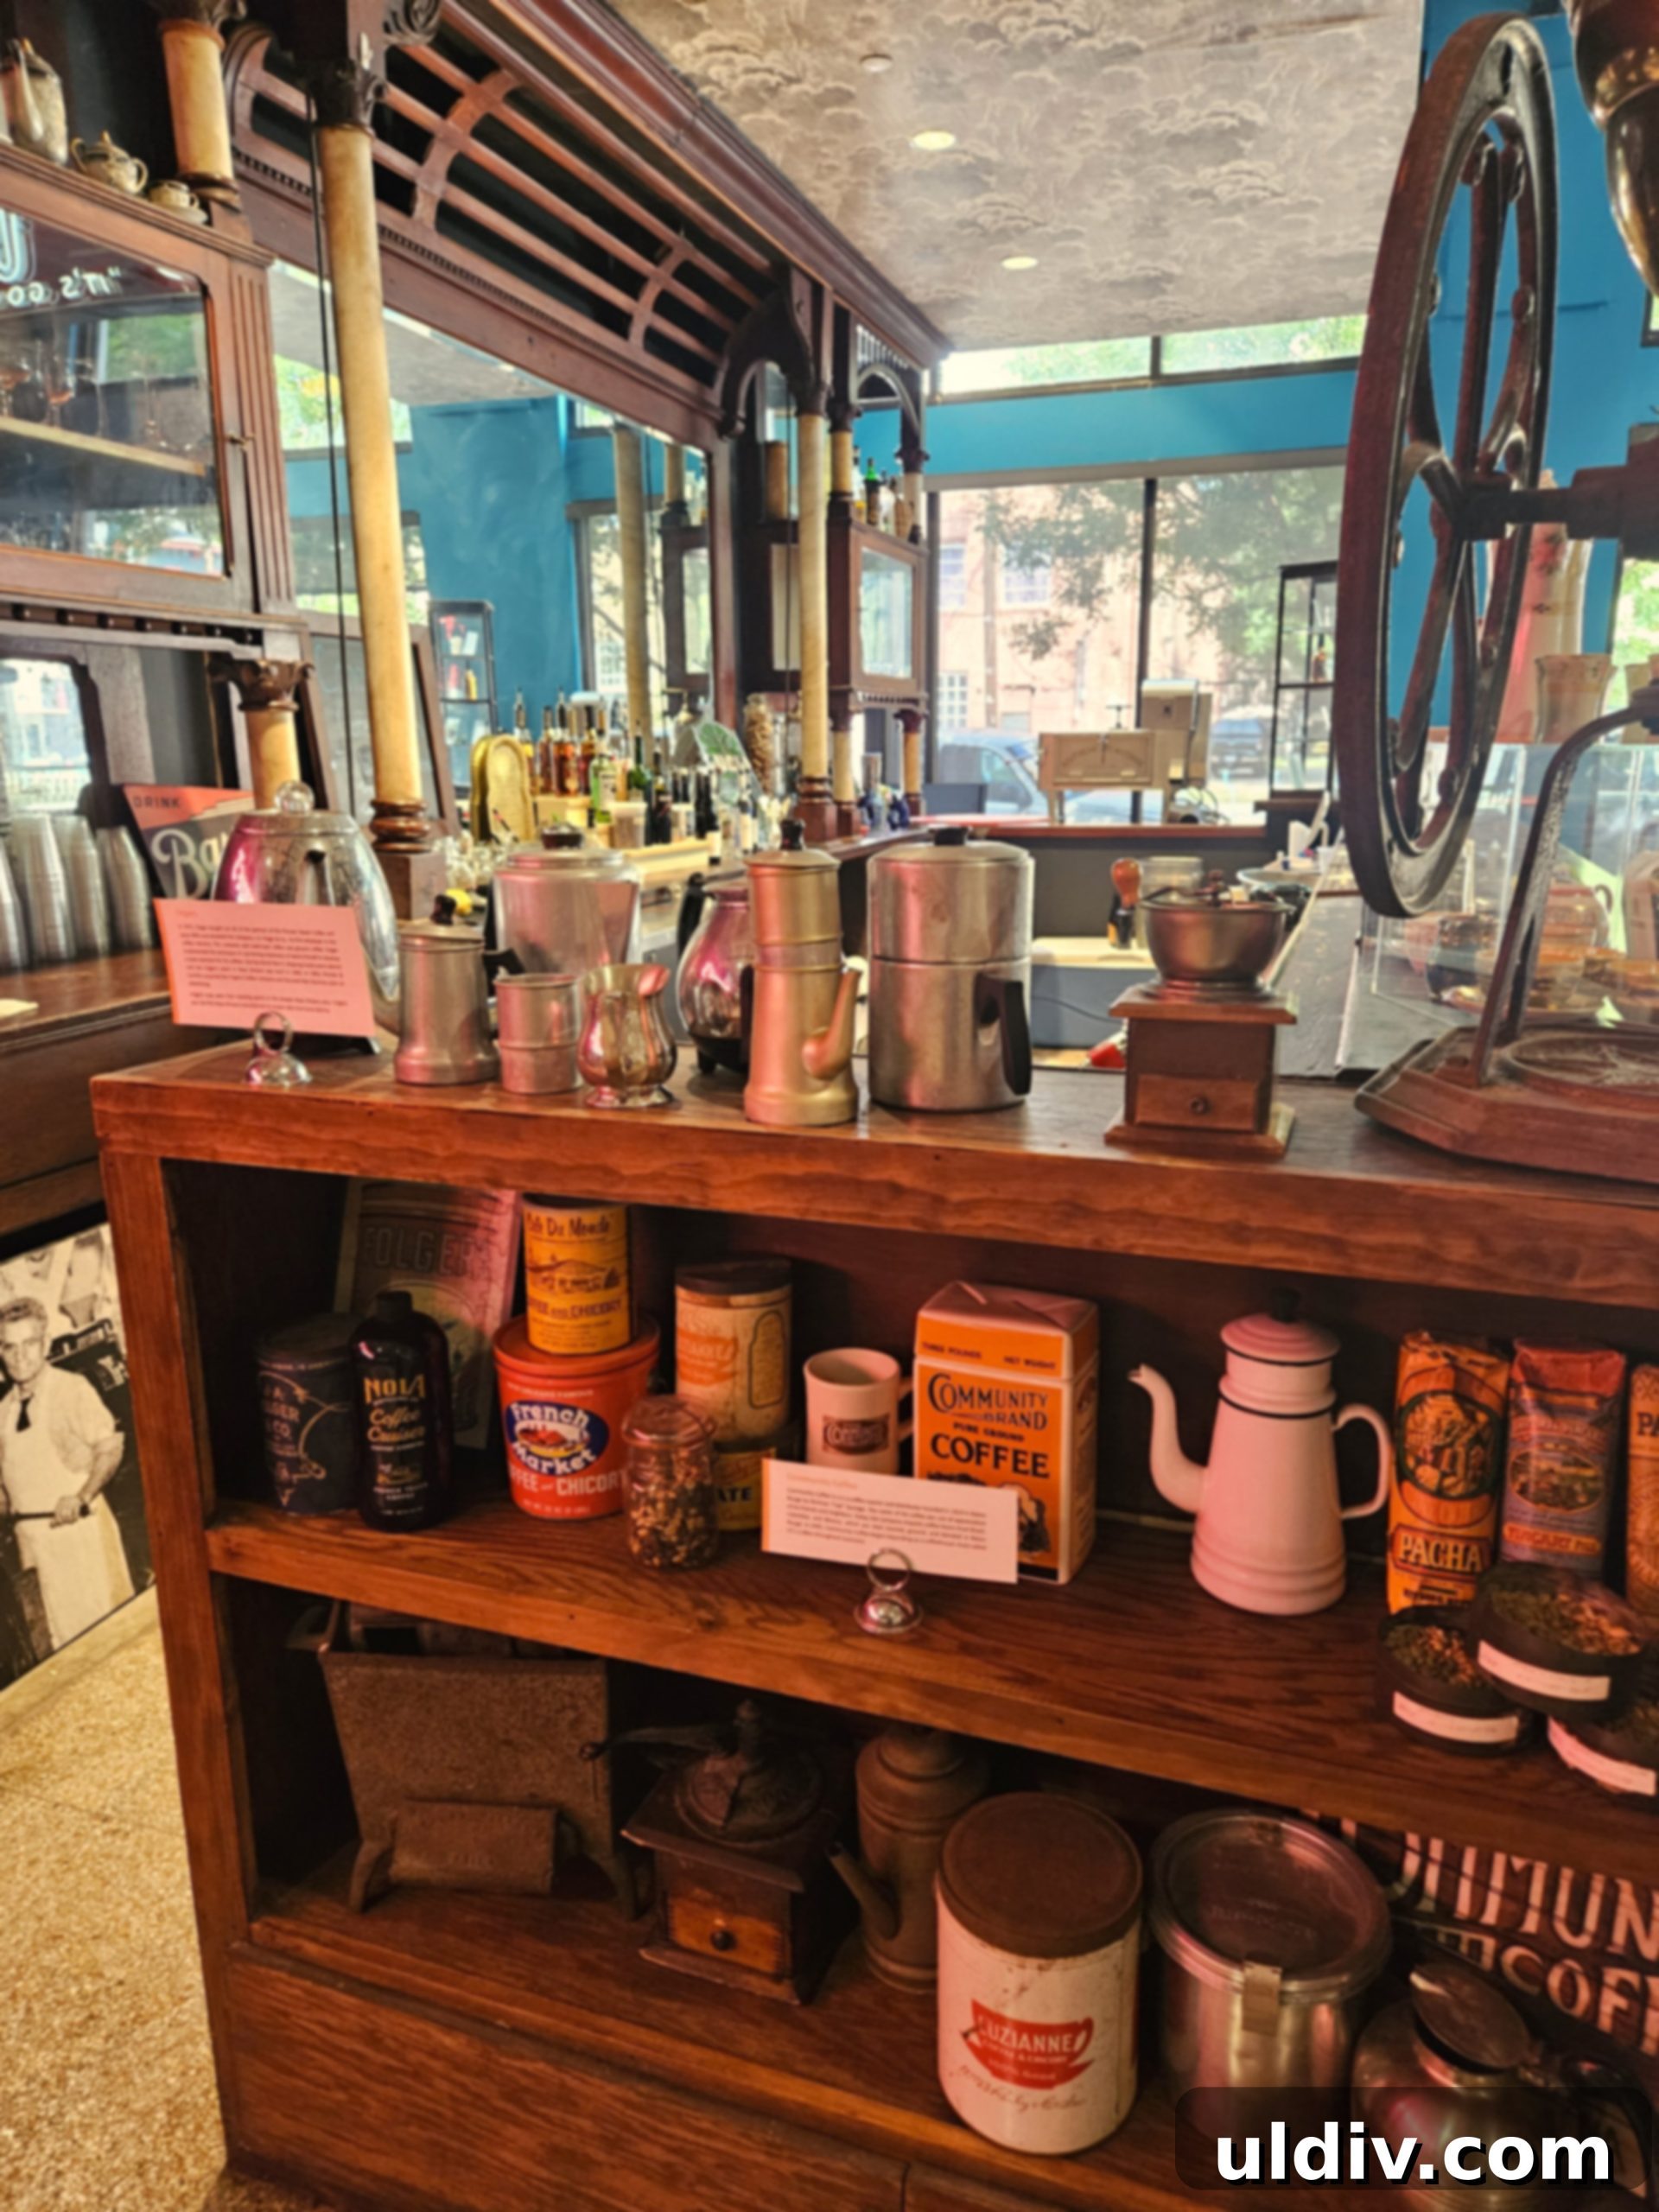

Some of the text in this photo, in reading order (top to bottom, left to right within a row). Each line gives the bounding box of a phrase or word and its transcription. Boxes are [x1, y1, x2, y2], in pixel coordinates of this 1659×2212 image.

[133, 796, 182, 809] DRINK
[922, 1341, 1055, 1370] THREE POUNDS NET WEIGHT
[364, 1374, 425, 1404] NOLA
[928, 1372, 1048, 1414] COMMUNITY
[369, 1406, 421, 1428] Coffee
[510, 1402, 590, 1429] French
[982, 1411, 1047, 1431] BRAND
[953, 1421, 1025, 1442] PURE GROUND
[512, 1441, 597, 1476] Market
[931, 1433, 1050, 1479] COFFEE
[716, 1487, 752, 1503] ATE
[1401, 1535, 1483, 1573] PACHA
[977, 2014, 1074, 2053] LUZIANNE
